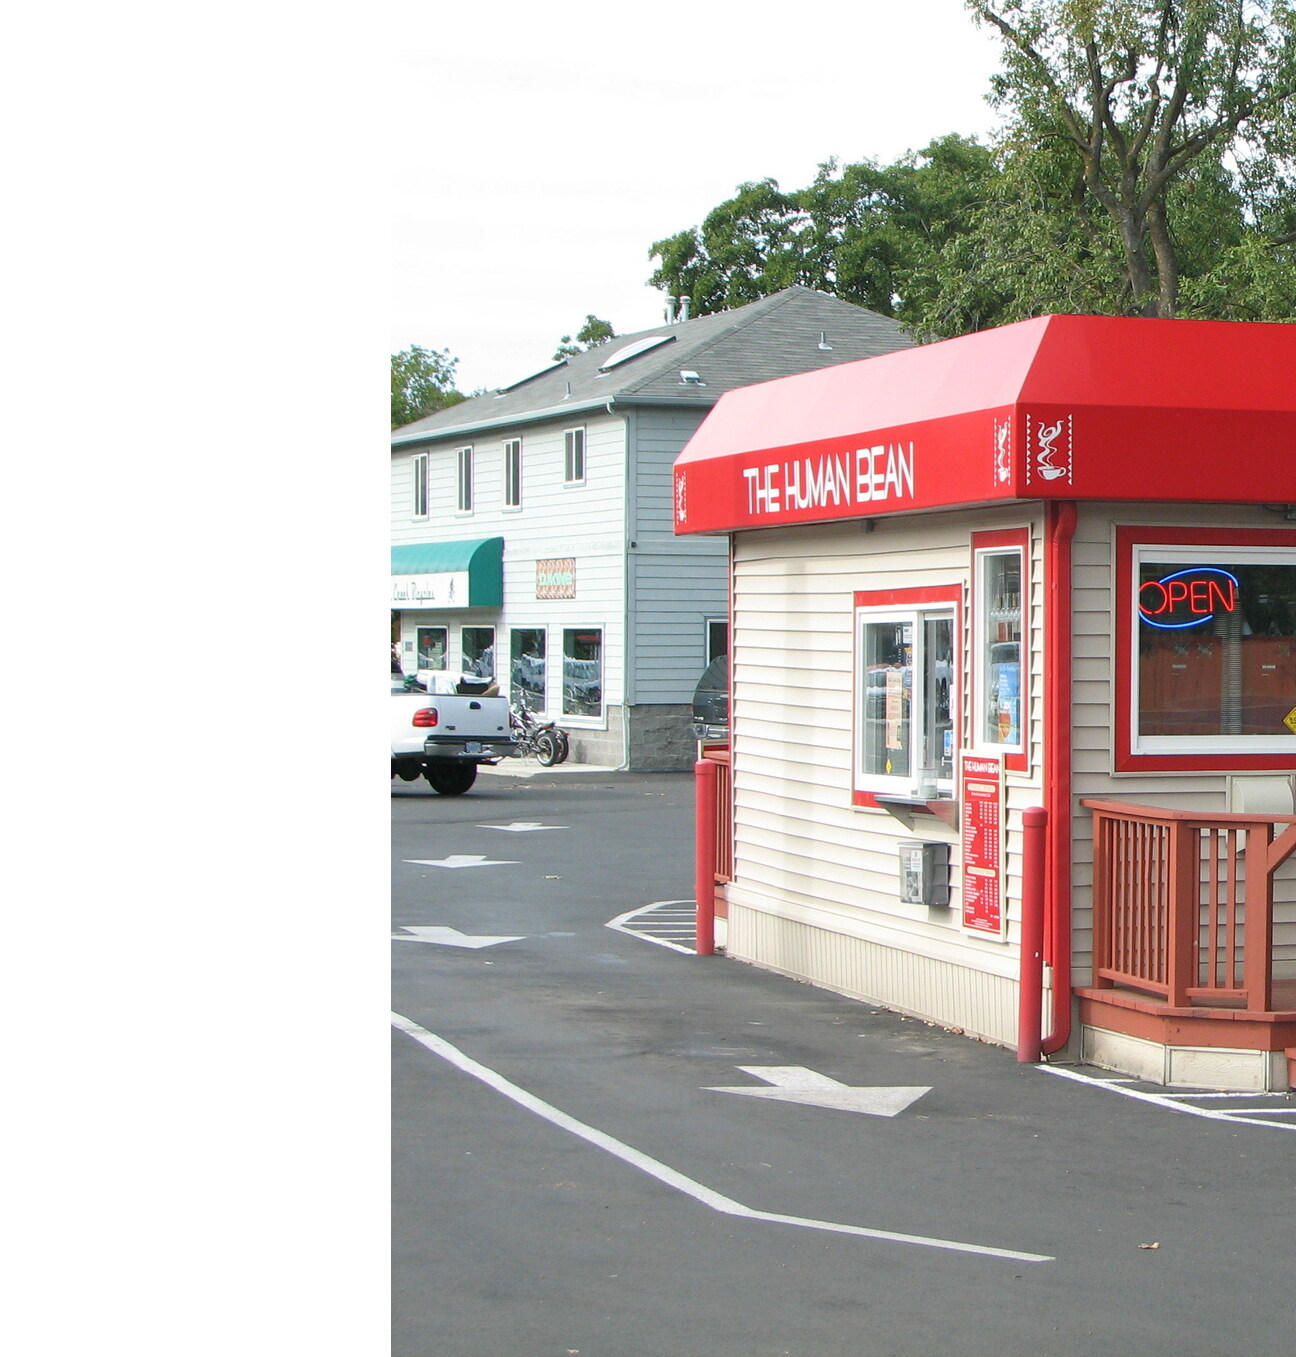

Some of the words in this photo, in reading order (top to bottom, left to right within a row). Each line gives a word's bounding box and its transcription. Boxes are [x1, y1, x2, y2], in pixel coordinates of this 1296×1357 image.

[743, 464, 780, 515] THE
[784, 452, 850, 511] HUMAN
[855, 441, 914, 502] BEAN
[1138, 579, 1235, 615] OPEN
[964, 760, 972, 772] THE
[972, 761, 987, 773] HUMAN
[987, 762, 999, 774] BEAN
